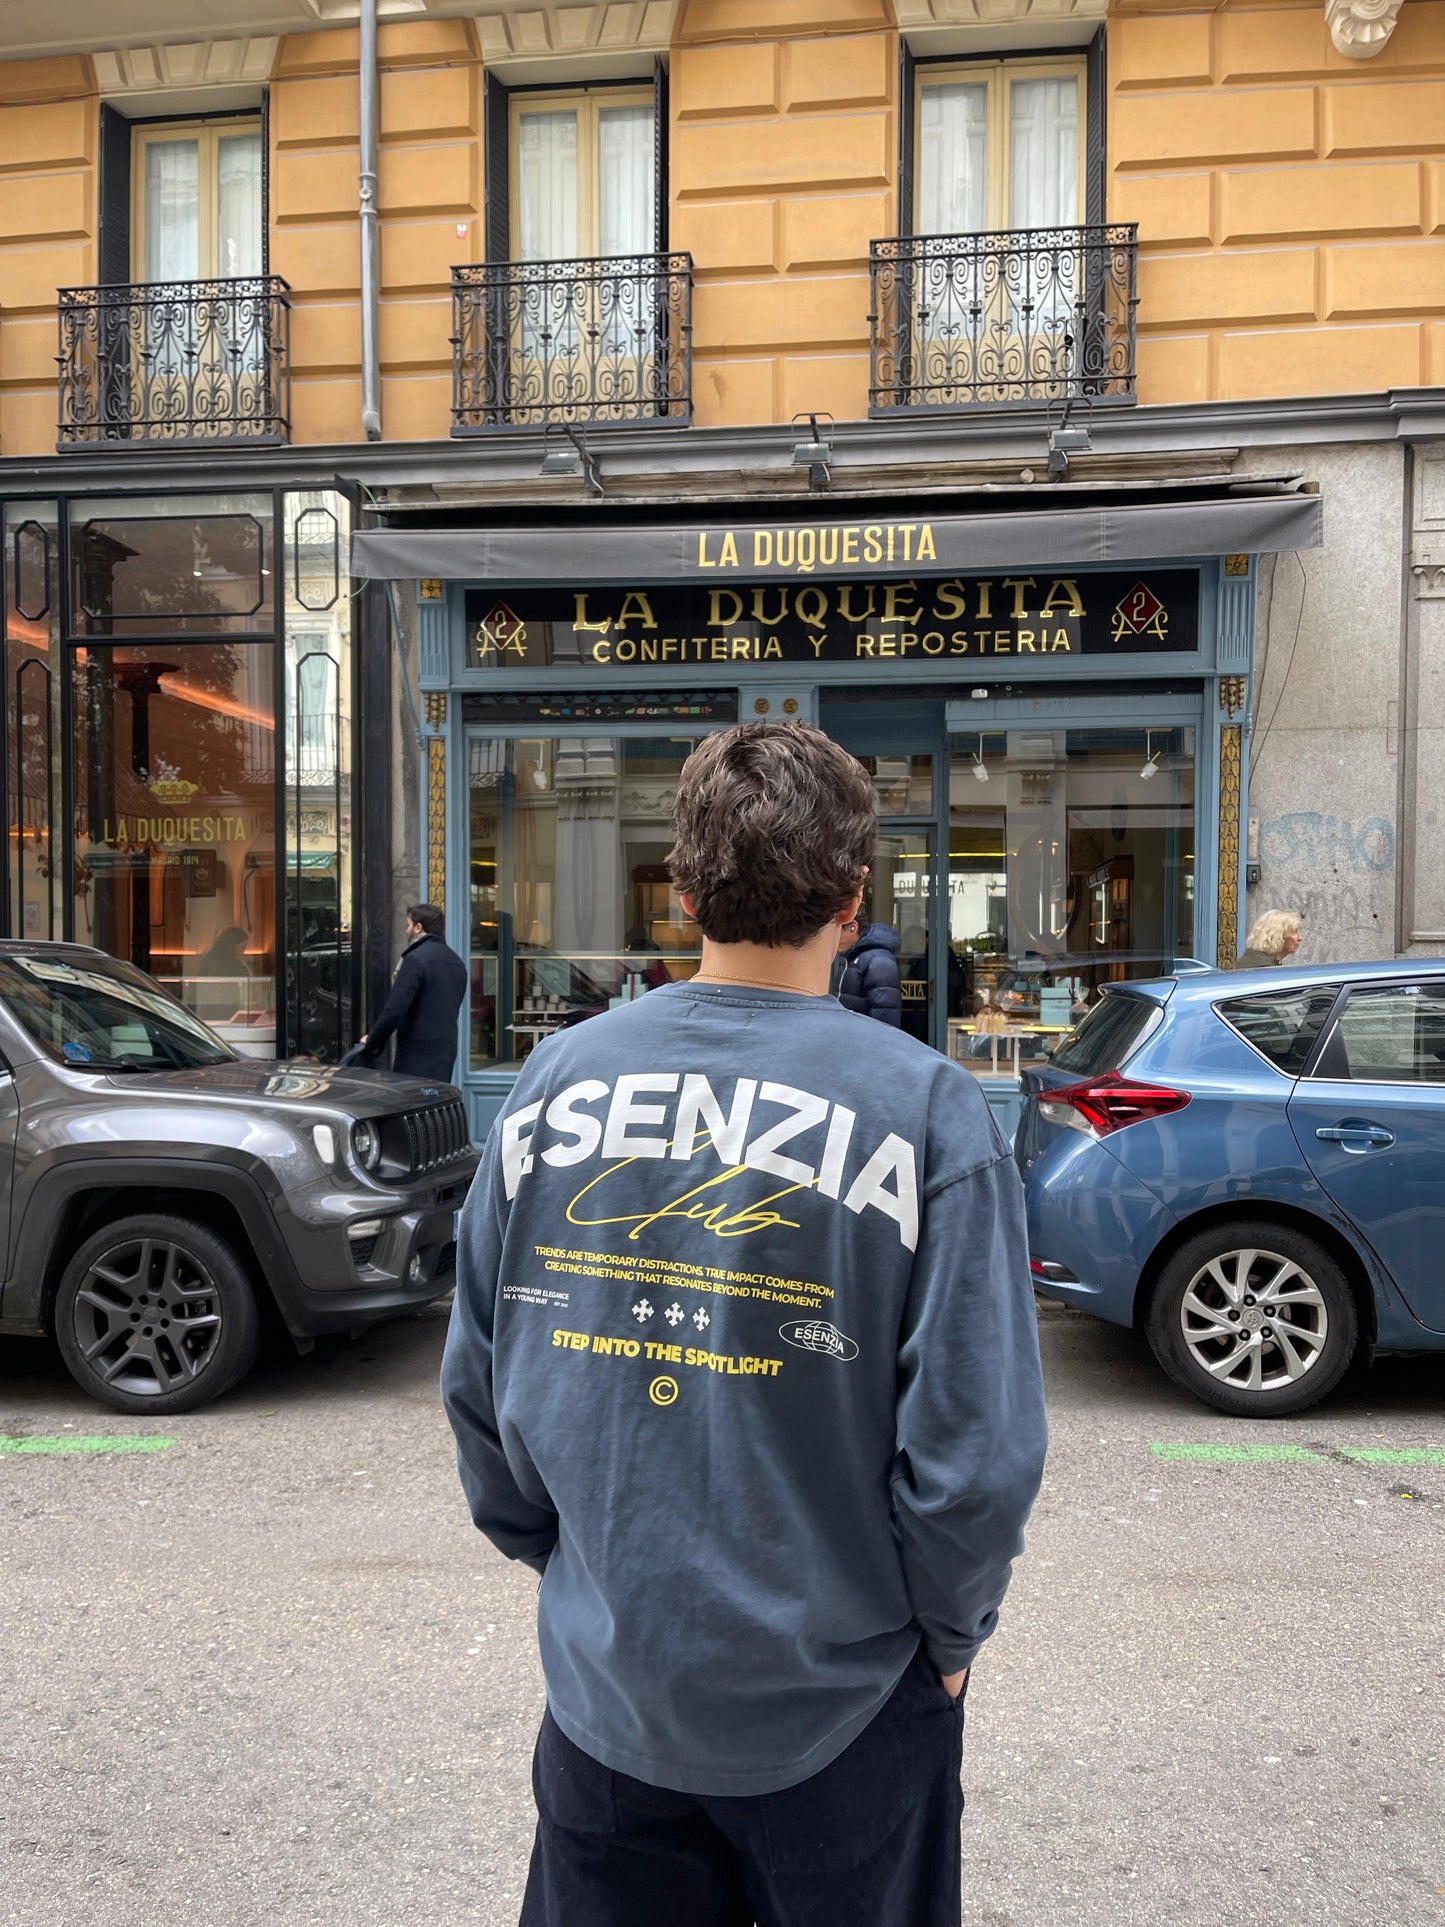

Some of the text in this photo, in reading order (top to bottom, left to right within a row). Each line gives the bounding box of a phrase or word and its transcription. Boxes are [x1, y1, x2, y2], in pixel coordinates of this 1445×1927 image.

[698, 525, 937, 572] LA DUQUESITA
[573, 577, 1086, 634] LA DUQUESITA
[592, 628, 1071, 662] CONFITERIA Y REPOSTERIA
[104, 816, 246, 846] LA DUQUESITA
[183, 855, 199, 865] 1914
[501, 1073, 920, 1255] ESENZIA
[566, 1130, 819, 1240] Club
[503, 1285, 570, 1300] LOOKING FOR ELEGANCE
[534, 1246, 566, 1259] TRENDS
[566, 1250, 583, 1261] ARE
[584, 1251, 638, 1267] TEMPORARY
[705, 1267, 727, 1280] TRUE
[727, 1271, 766, 1284] IMPACT
[765, 1277, 803, 1291] COMES
[804, 1283, 835, 1298] FROM
[545, 1260, 822, 1309] CREATING SOMETHING THAT RESONATES BEYOND THE MOMENT.
[517, 1294, 535, 1303] YOUNG
[552, 1329, 783, 1376] STEP INTO THE SPOTLIGHT
[794, 1327, 844, 1354] ESENZIA
